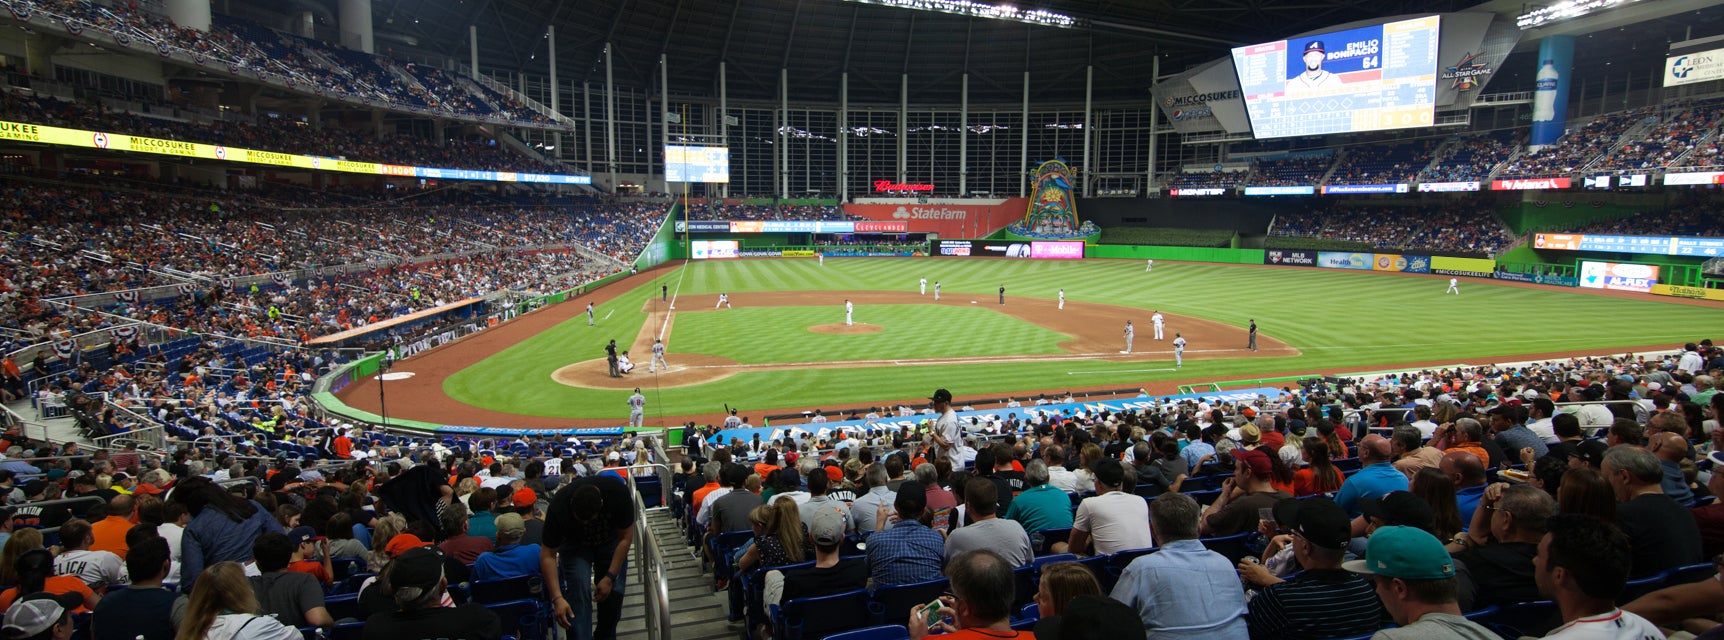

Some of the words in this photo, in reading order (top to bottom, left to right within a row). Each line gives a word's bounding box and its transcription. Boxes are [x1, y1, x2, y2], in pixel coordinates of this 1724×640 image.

[1347, 40, 1378, 50] EMILIO
[1328, 46, 1378, 60] BONIFACIO
[1363, 56, 1378, 68] 64
[1687, 56, 1713, 66] LEON
[1174, 90, 1239, 105] MICCOSUKEE
[1182, 106, 1211, 120] pepsi
[1385, 115, 1392, 125] 3
[1402, 114, 1412, 124] 0
[1420, 112, 1430, 122] 0
[130, 137, 195, 150] MICCOSUKEE
[247, 151, 292, 161] MICCOSUKEE
[338, 161, 375, 170] MICCOSUKEE
[874, 180, 935, 192] Budweiser
[1502, 180, 1512, 190] Fly
[1512, 179, 1549, 189] Avianca
[855, 223, 905, 231] CLEVELANDER
[1436, 270, 1490, 278] #MICCOSUKEELIFE
[1610, 278, 1648, 287] AL-FLEX
[549, 466, 559, 475] 21
